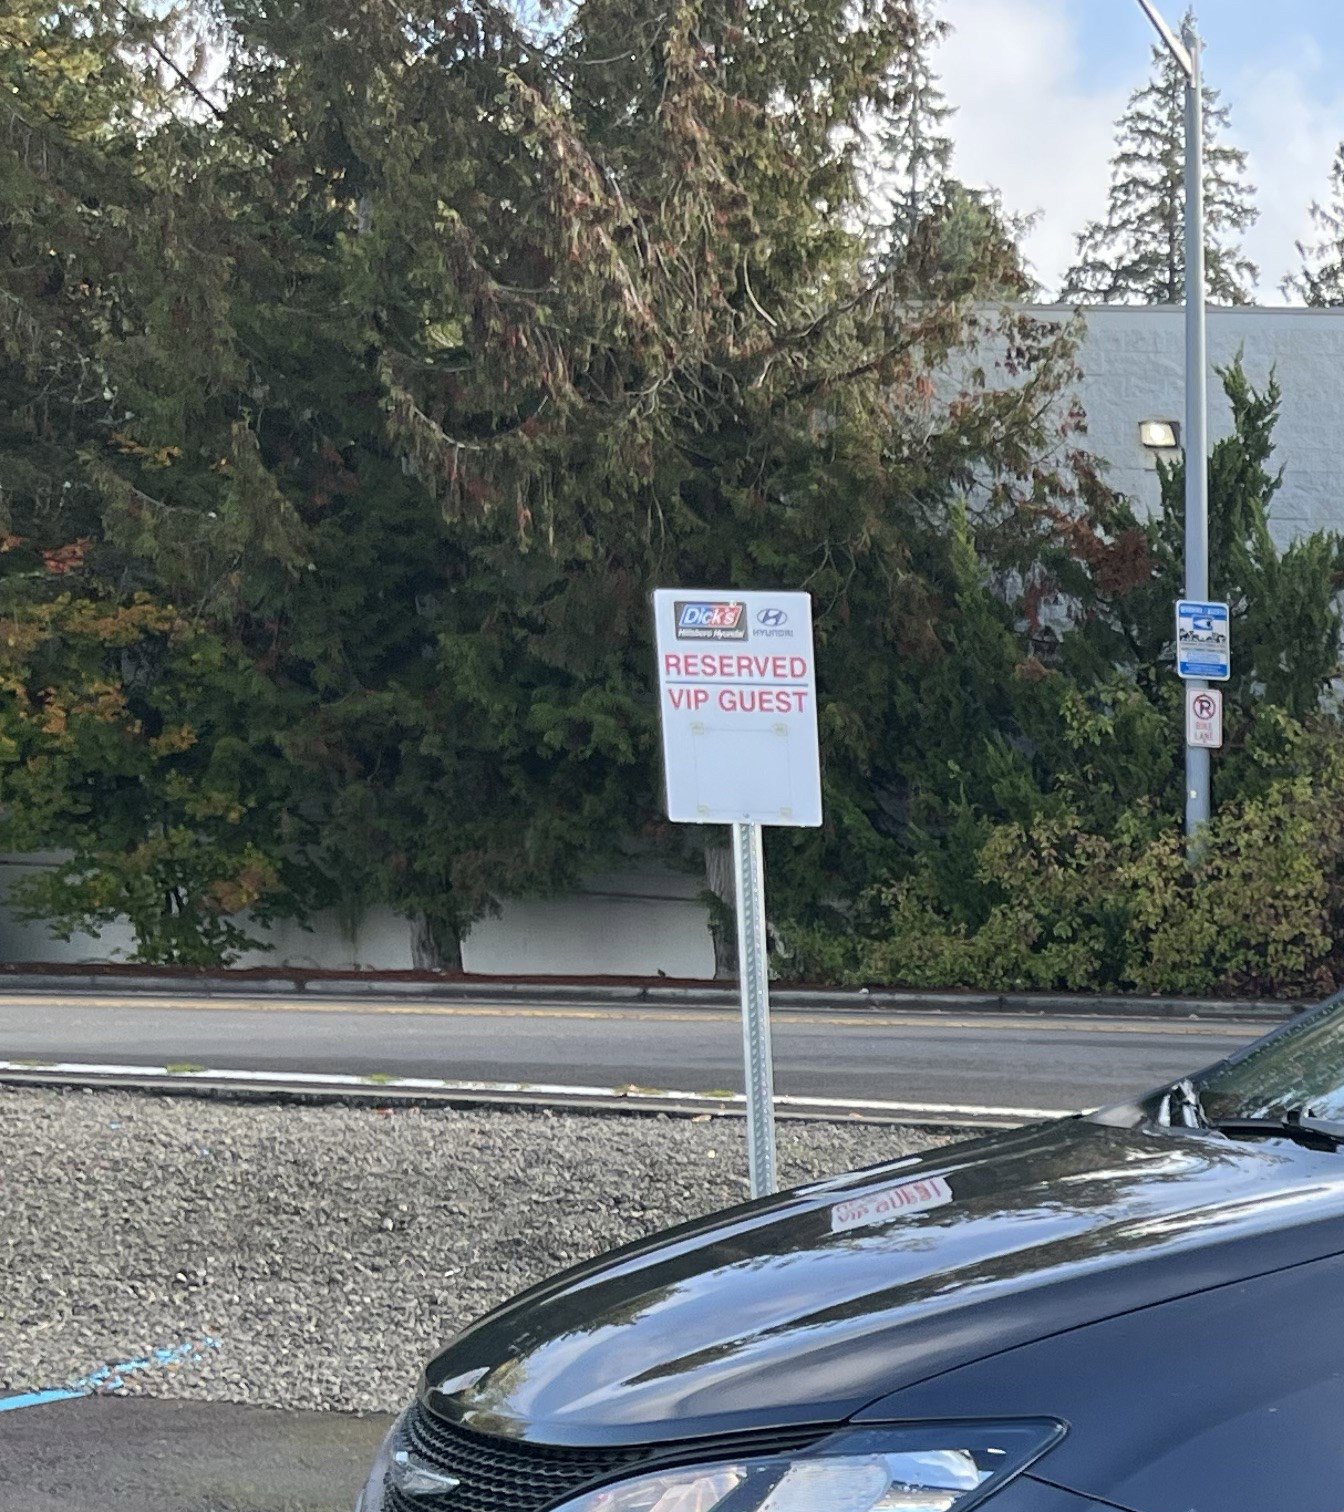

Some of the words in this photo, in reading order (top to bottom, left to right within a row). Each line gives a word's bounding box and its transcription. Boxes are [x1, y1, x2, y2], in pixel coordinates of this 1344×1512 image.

[684, 607, 736, 625] Dick's
[665, 654, 807, 678] RESERVED
[668, 689, 709, 711] VIP
[719, 689, 808, 713] GUEST
